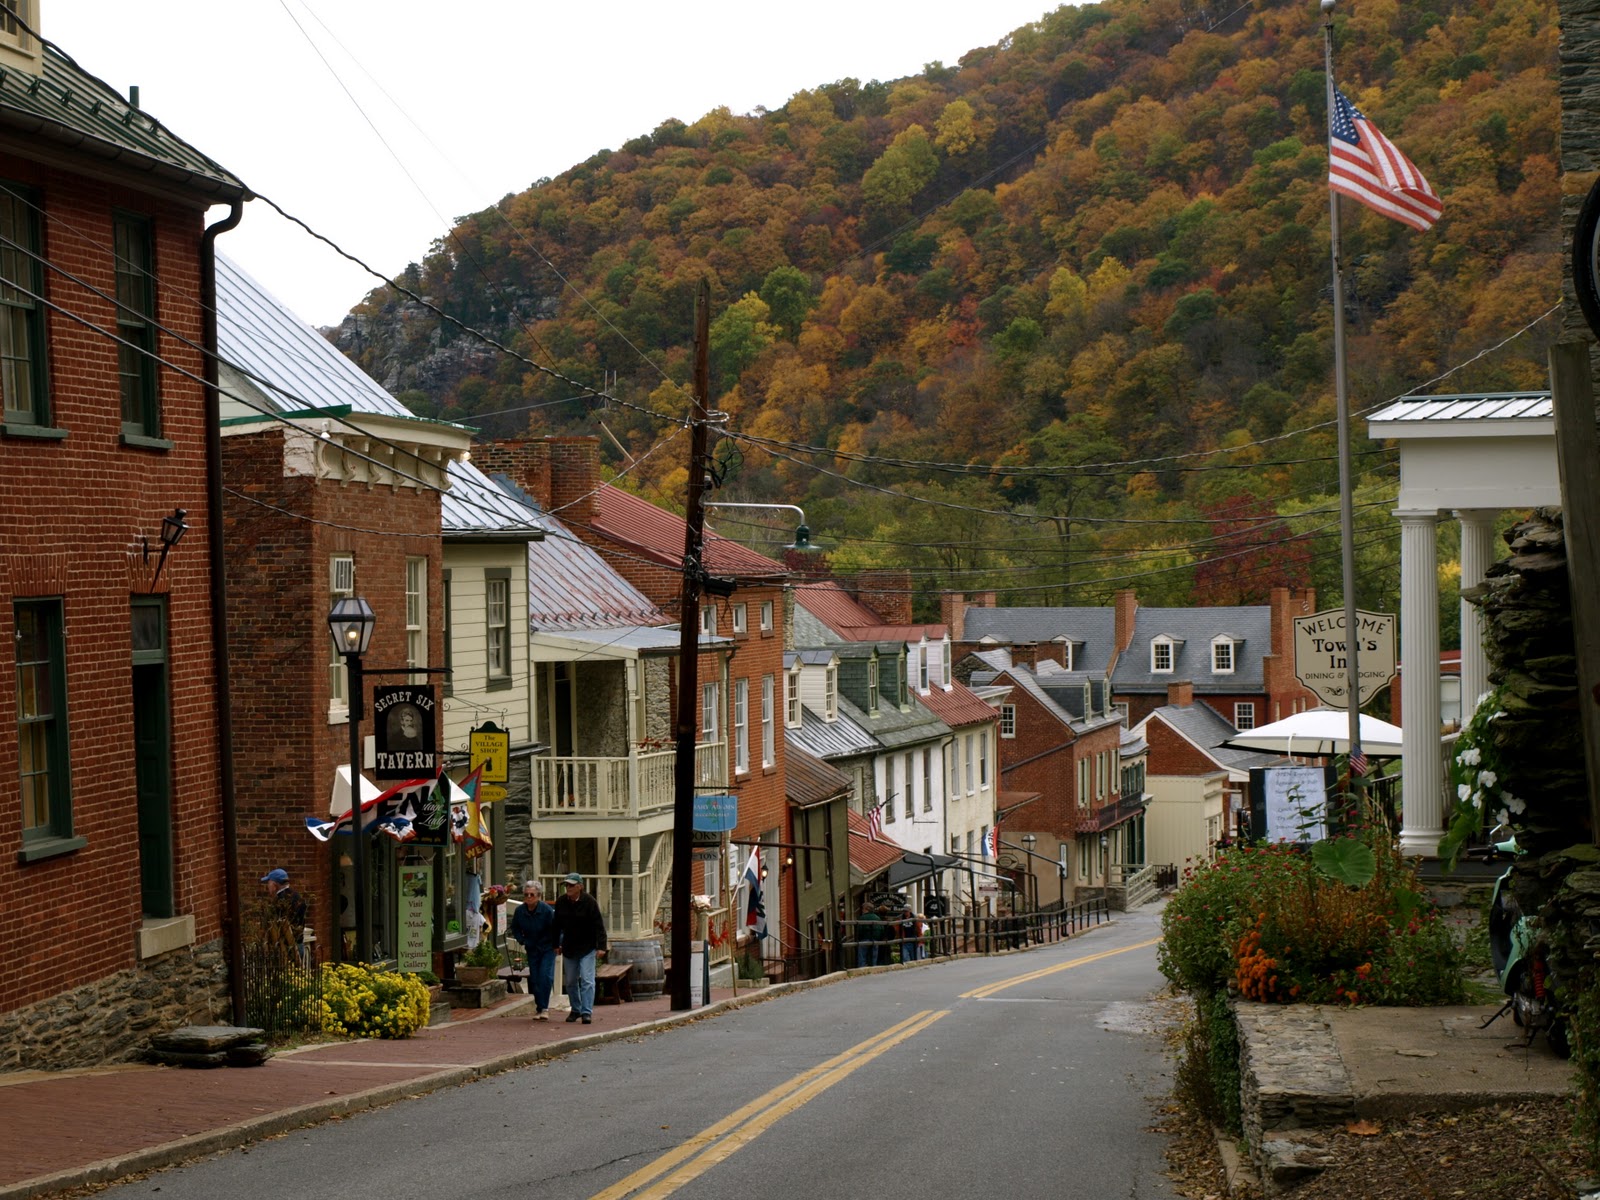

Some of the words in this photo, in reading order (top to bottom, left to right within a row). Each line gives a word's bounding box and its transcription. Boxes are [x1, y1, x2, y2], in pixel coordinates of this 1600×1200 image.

[1330, 655, 1359, 668] In
[1305, 672, 1335, 680] DINING
[374, 691, 412, 712] SECRET
[415, 694, 435, 711] SIX
[377, 751, 435, 770] TAVERN
[418, 812, 447, 830] Lady
[692, 831, 717, 841] OKS
[403, 961, 428, 969] Gallery
